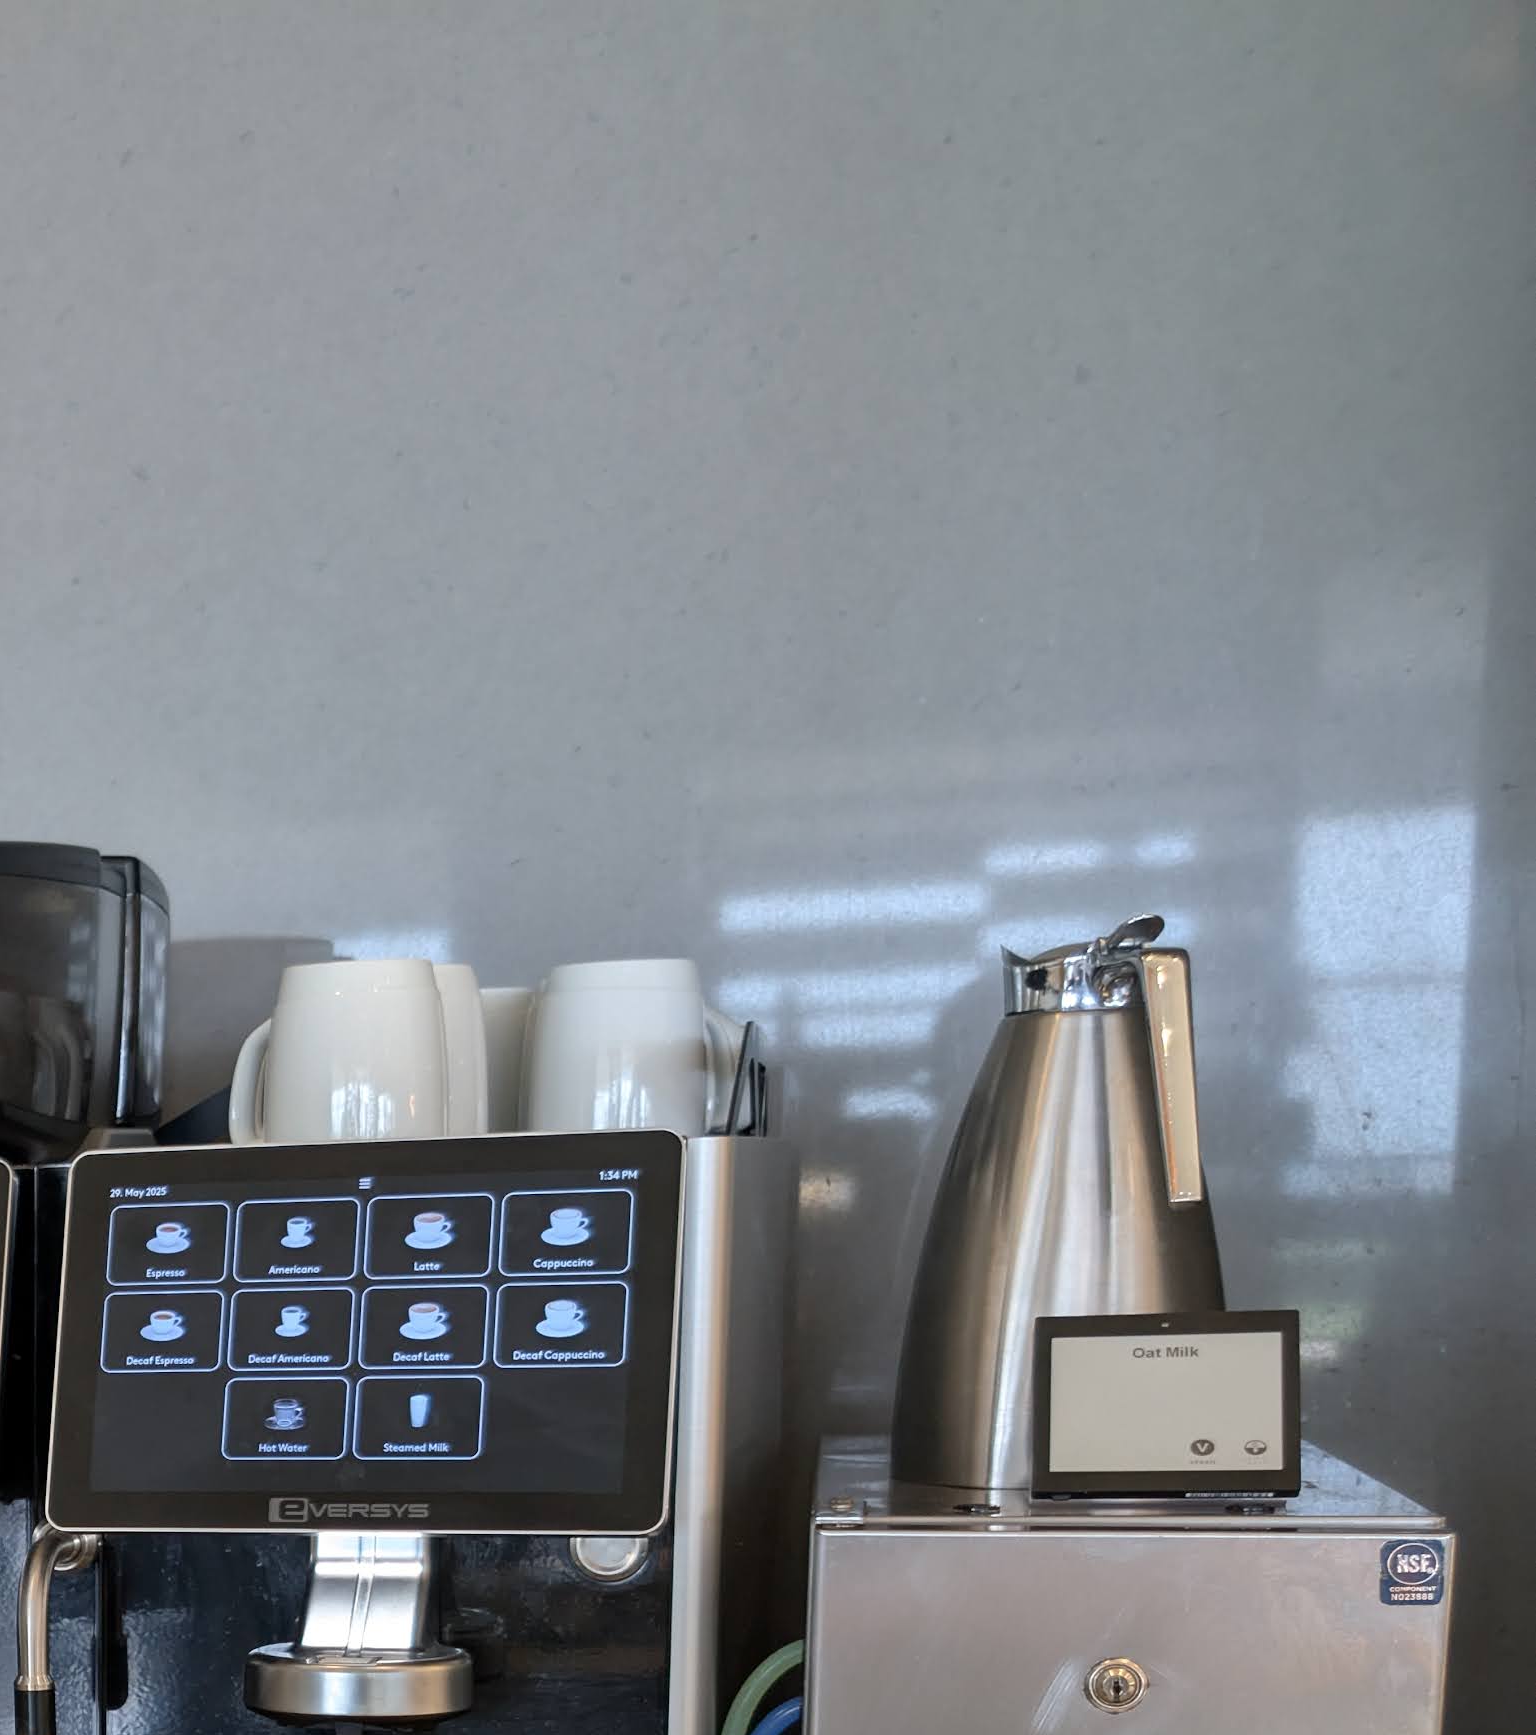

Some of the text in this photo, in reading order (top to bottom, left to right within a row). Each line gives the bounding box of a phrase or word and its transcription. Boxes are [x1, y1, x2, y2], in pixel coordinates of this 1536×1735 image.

[599, 1170, 639, 1181] 1:34 PM
[124, 1188, 144, 1199] May
[145, 1186, 168, 1197] 2025
[268, 1264, 321, 1275] Americano
[413, 1261, 441, 1271] Latte
[533, 1258, 595, 1271] Cappuccino
[145, 1268, 186, 1279] Espresso
[392, 1351, 451, 1362] Decaf Latte
[512, 1350, 605, 1361] Decaf Cappuccino
[1132, 1345, 1200, 1359] Oat Milk
[126, 1355, 195, 1366] Decaf Espresso
[247, 1353, 330, 1364] Decaf Americano
[258, 1443, 309, 1453] Hot Water
[382, 1441, 450, 1453] Steamed Milk
[1396, 1553, 1432, 1574] NSF
